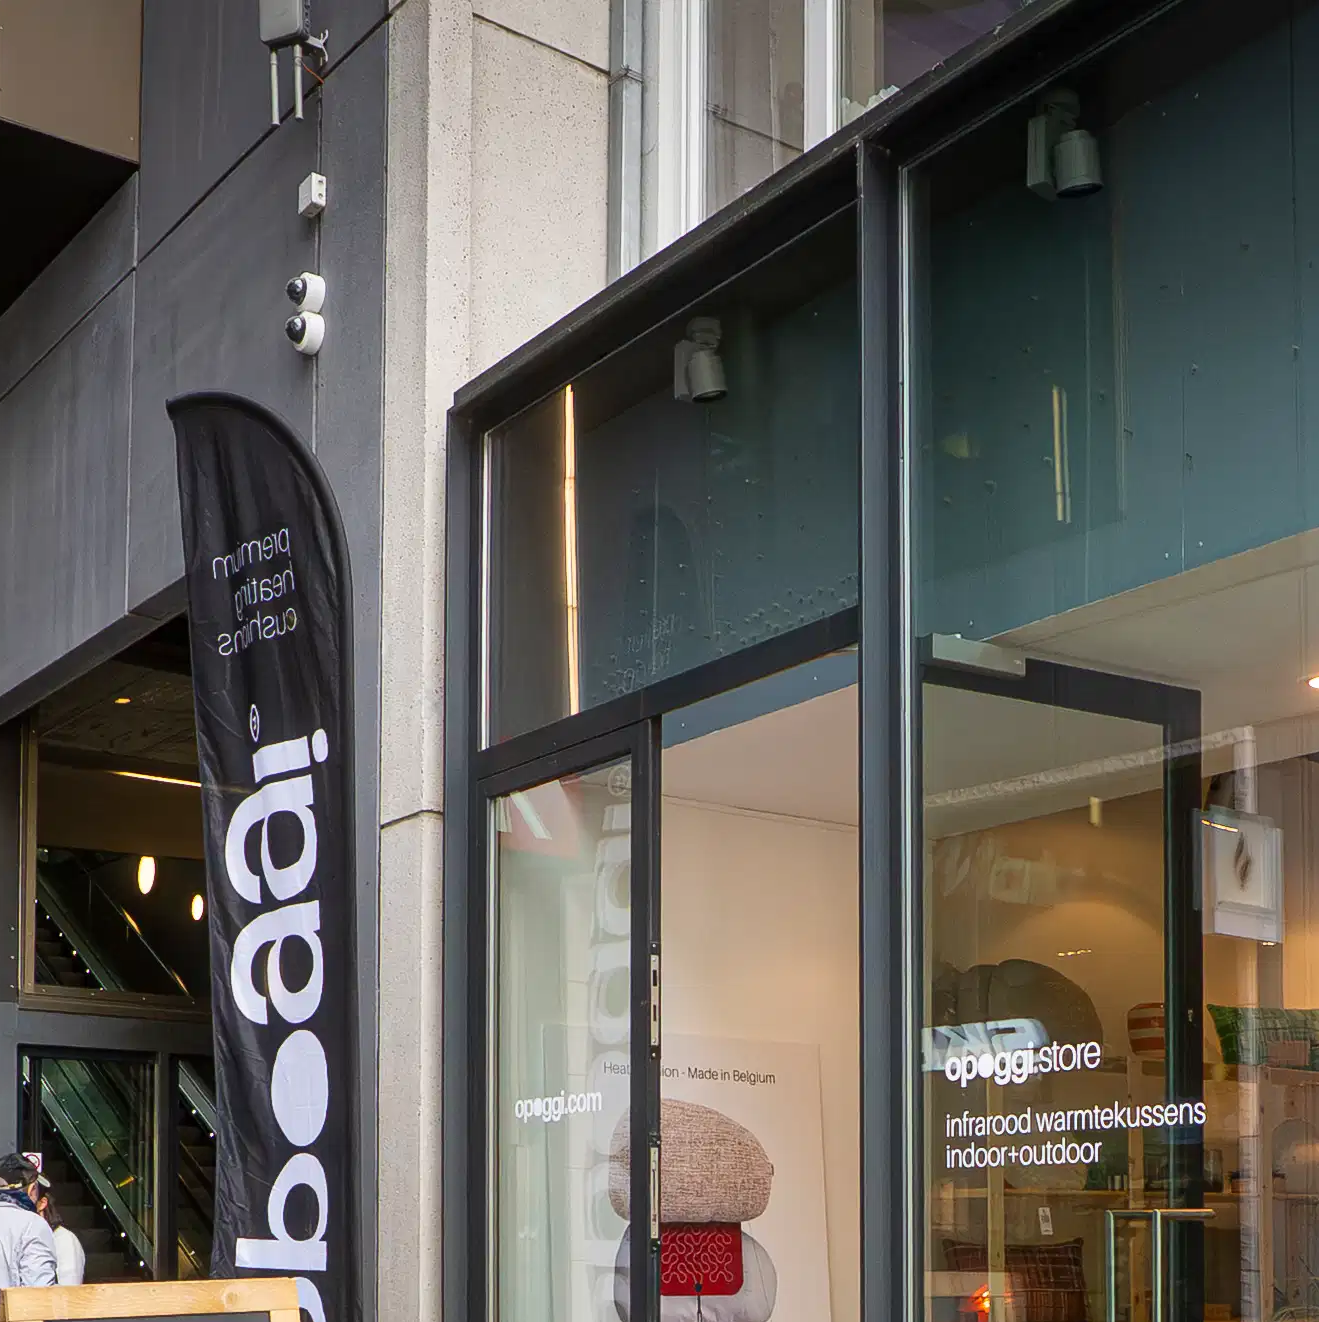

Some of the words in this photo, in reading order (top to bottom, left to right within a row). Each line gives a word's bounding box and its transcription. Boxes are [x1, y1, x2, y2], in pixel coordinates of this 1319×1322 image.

[603, 1061, 630, 1075] Heat
[661, 1064, 679, 1078] ion
[687, 1067, 719, 1081] Made
[720, 1068, 730, 1081] in
[733, 1069, 776, 1086] Belgium
[944, 1040, 1102, 1088] opoggi.store
[514, 1090, 602, 1124] opoggi.com
[945, 1107, 1032, 1138] infrarood
[1036, 1101, 1207, 1134] warmtekussens
[945, 1138, 1103, 1169] indoor+outdoor
